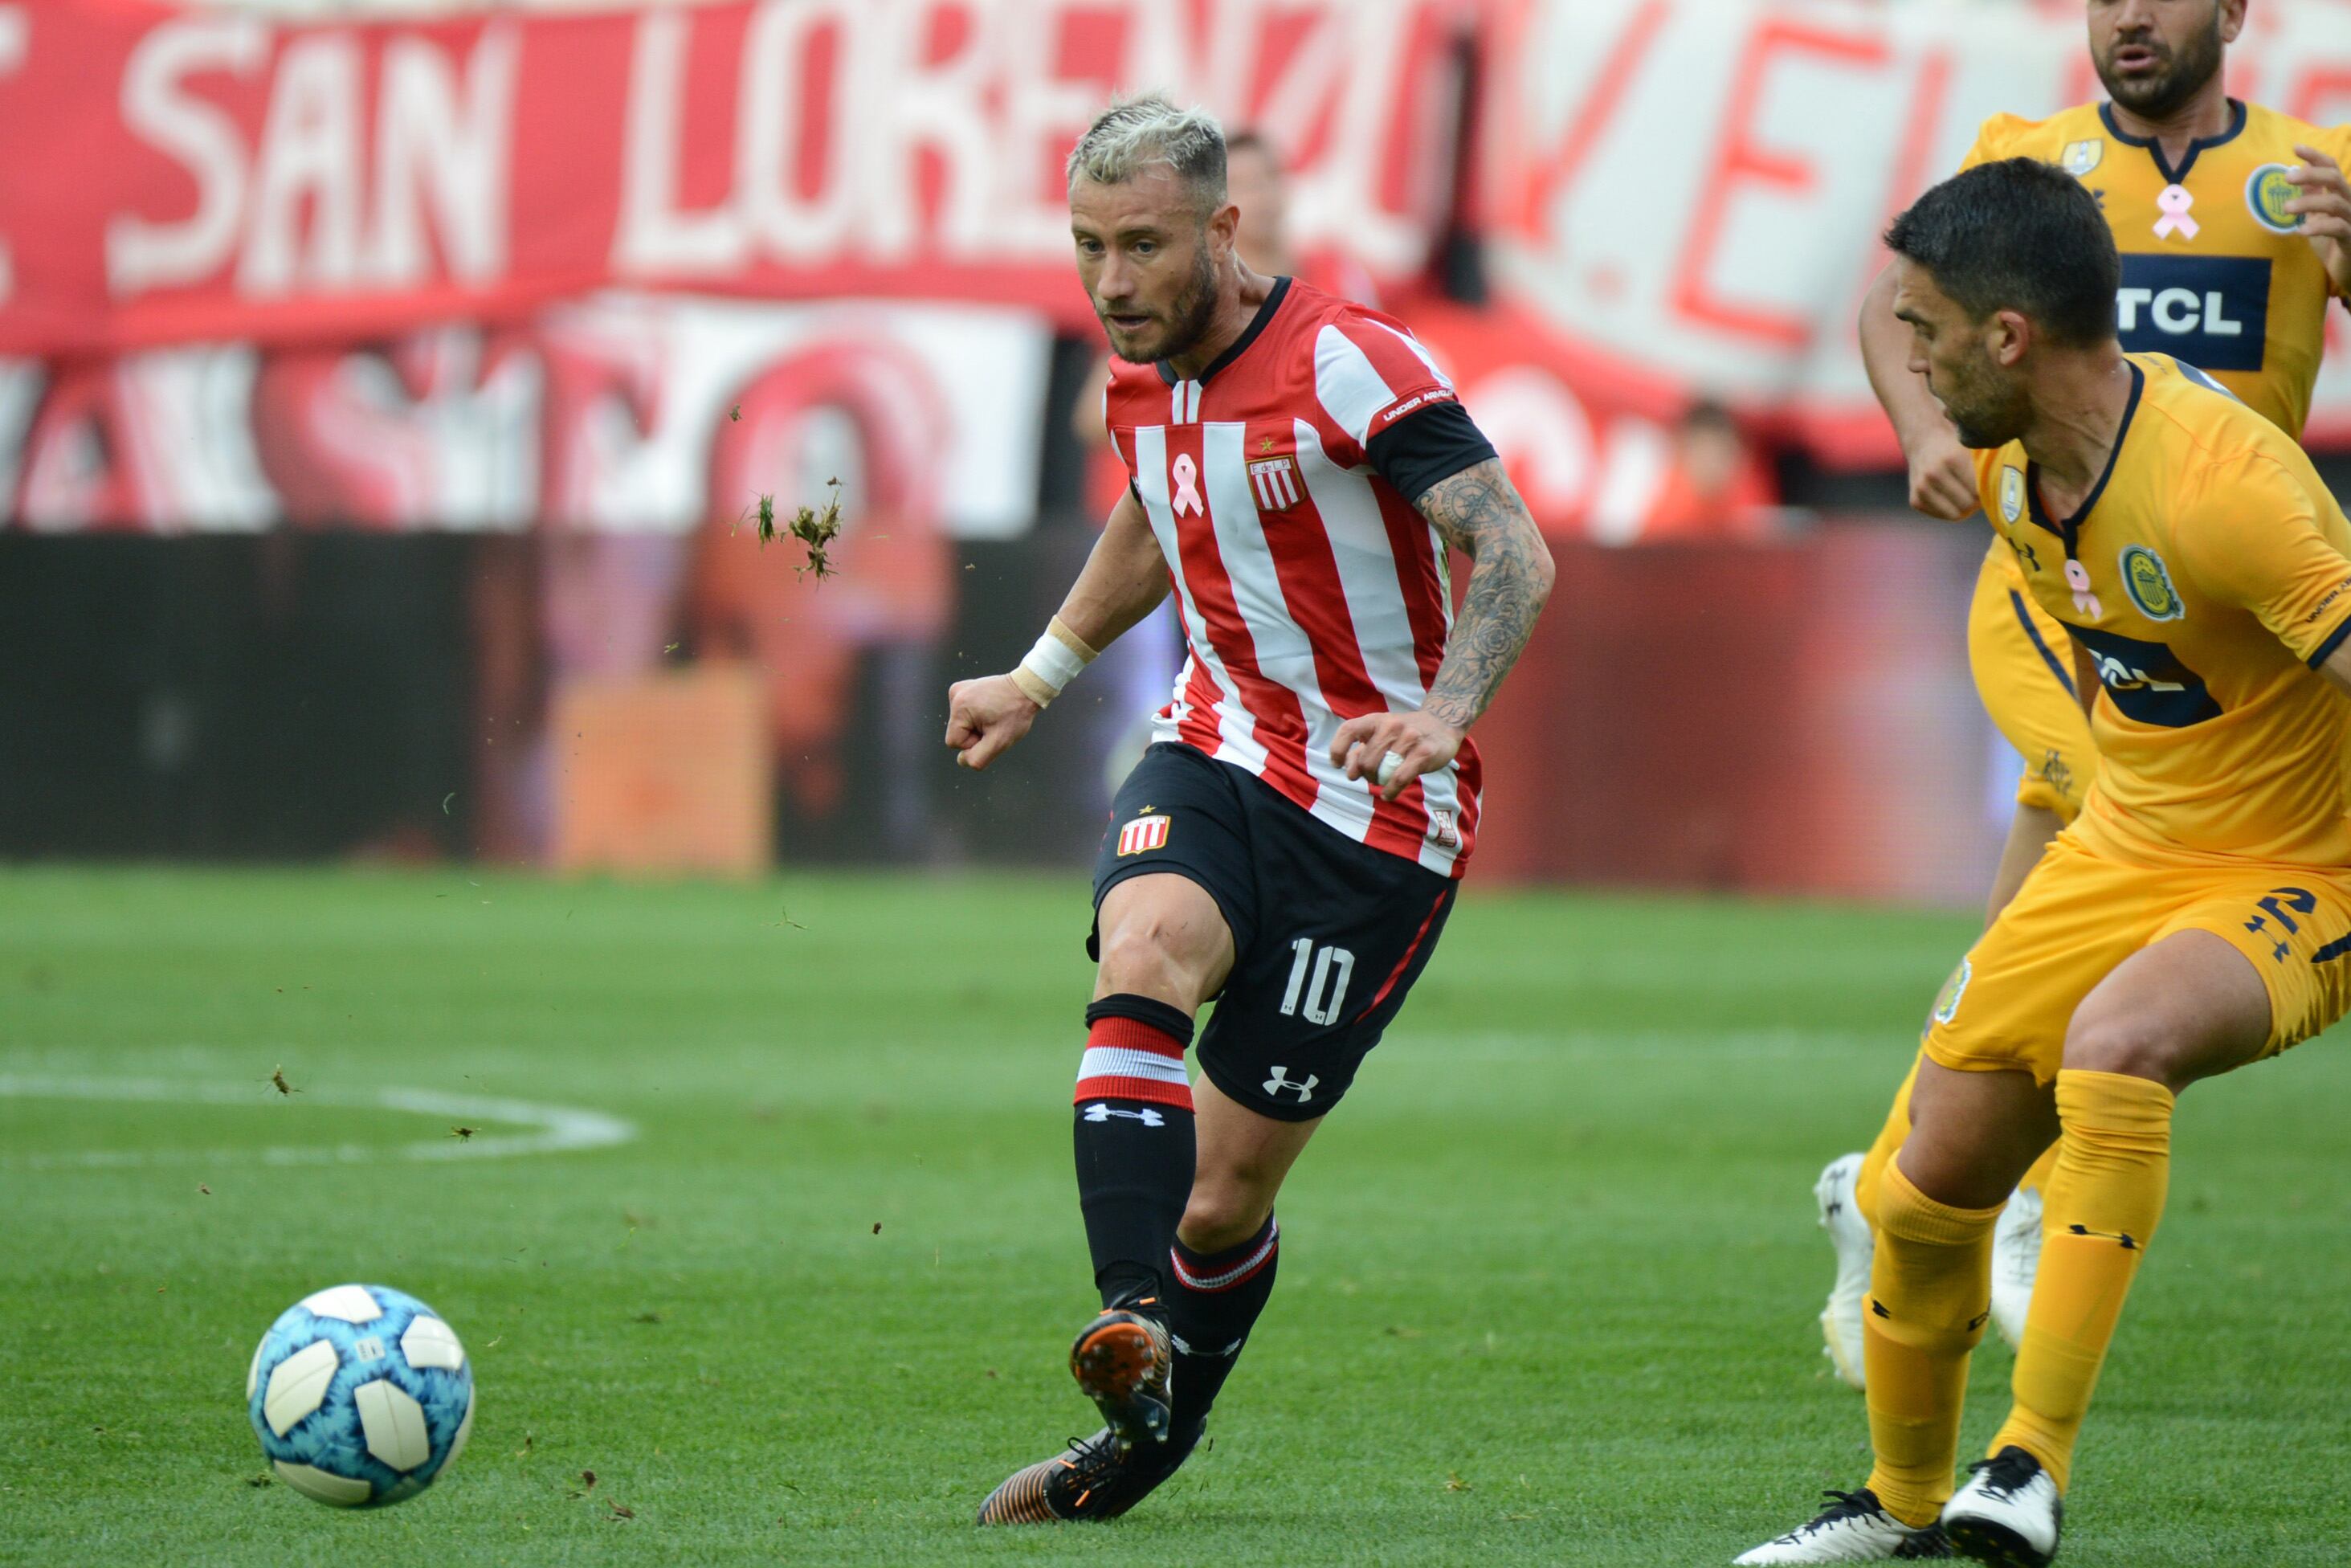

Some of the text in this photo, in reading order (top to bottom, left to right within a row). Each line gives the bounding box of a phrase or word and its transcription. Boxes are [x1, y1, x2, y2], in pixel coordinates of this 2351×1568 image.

[107, 14, 524, 302] SAN
[2116, 288, 2243, 336] TCL
[1383, 397, 1422, 422] UNDER
[1280, 937, 1356, 1027] 10
